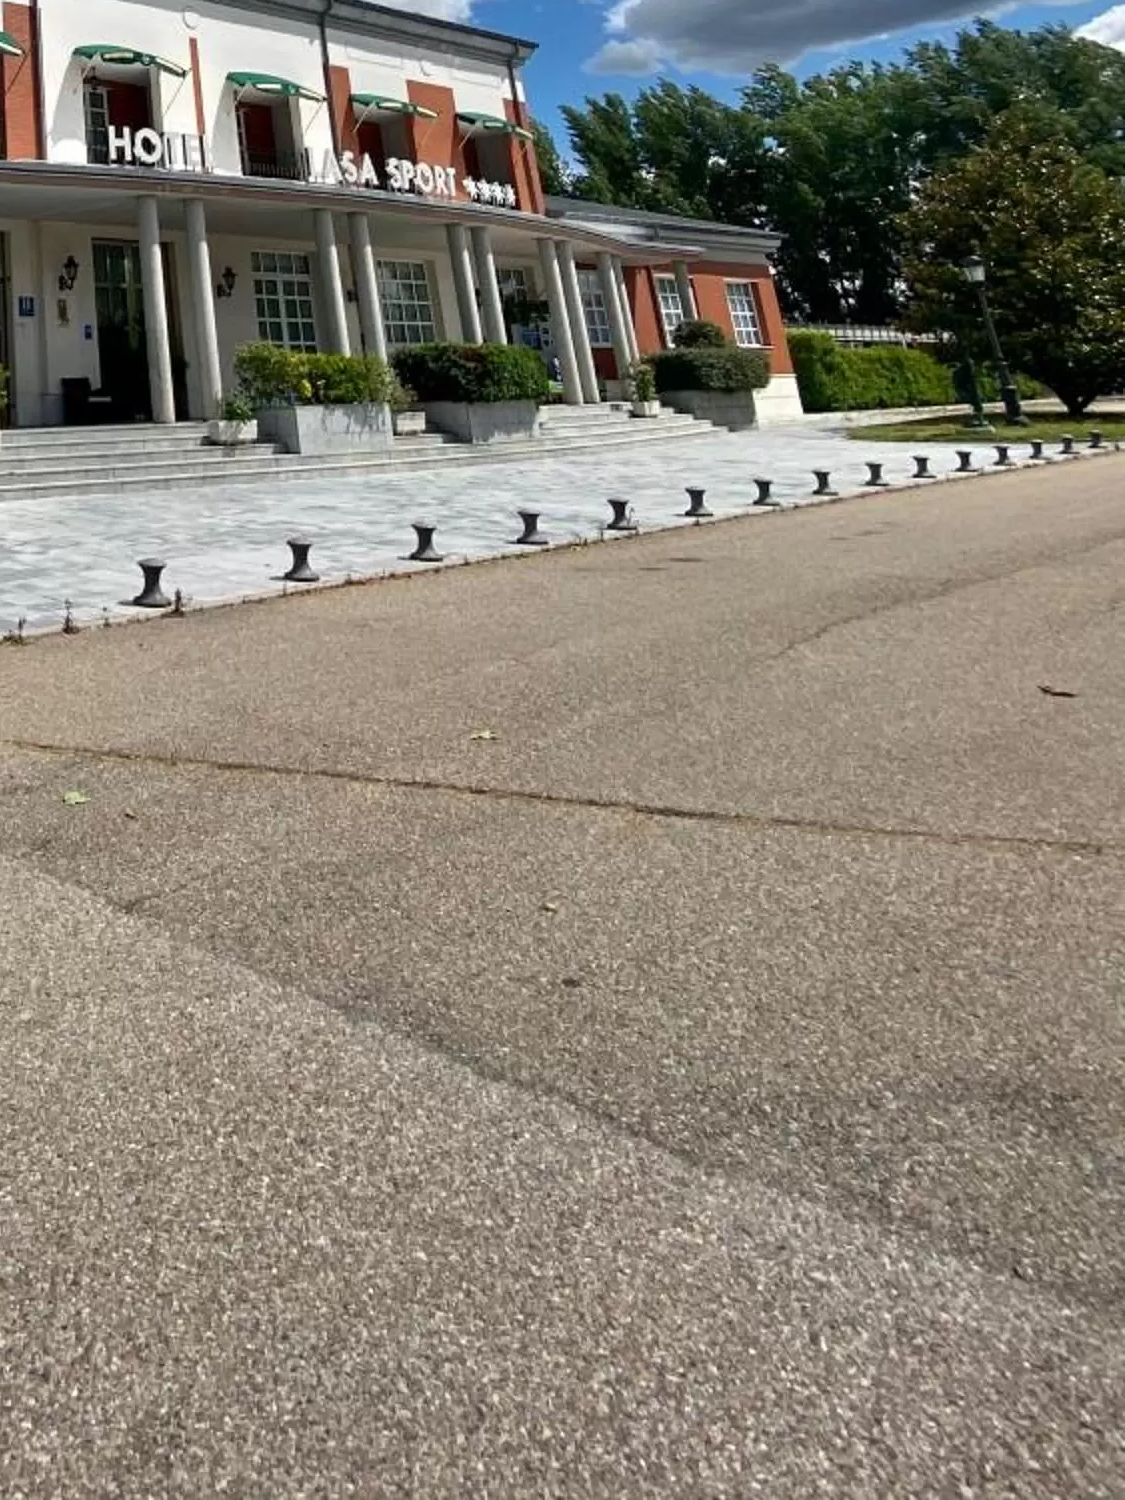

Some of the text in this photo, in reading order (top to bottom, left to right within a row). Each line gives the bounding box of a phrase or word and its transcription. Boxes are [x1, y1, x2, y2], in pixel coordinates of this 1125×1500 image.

[108, 125, 456, 197] HOTEL LASA SPORT
